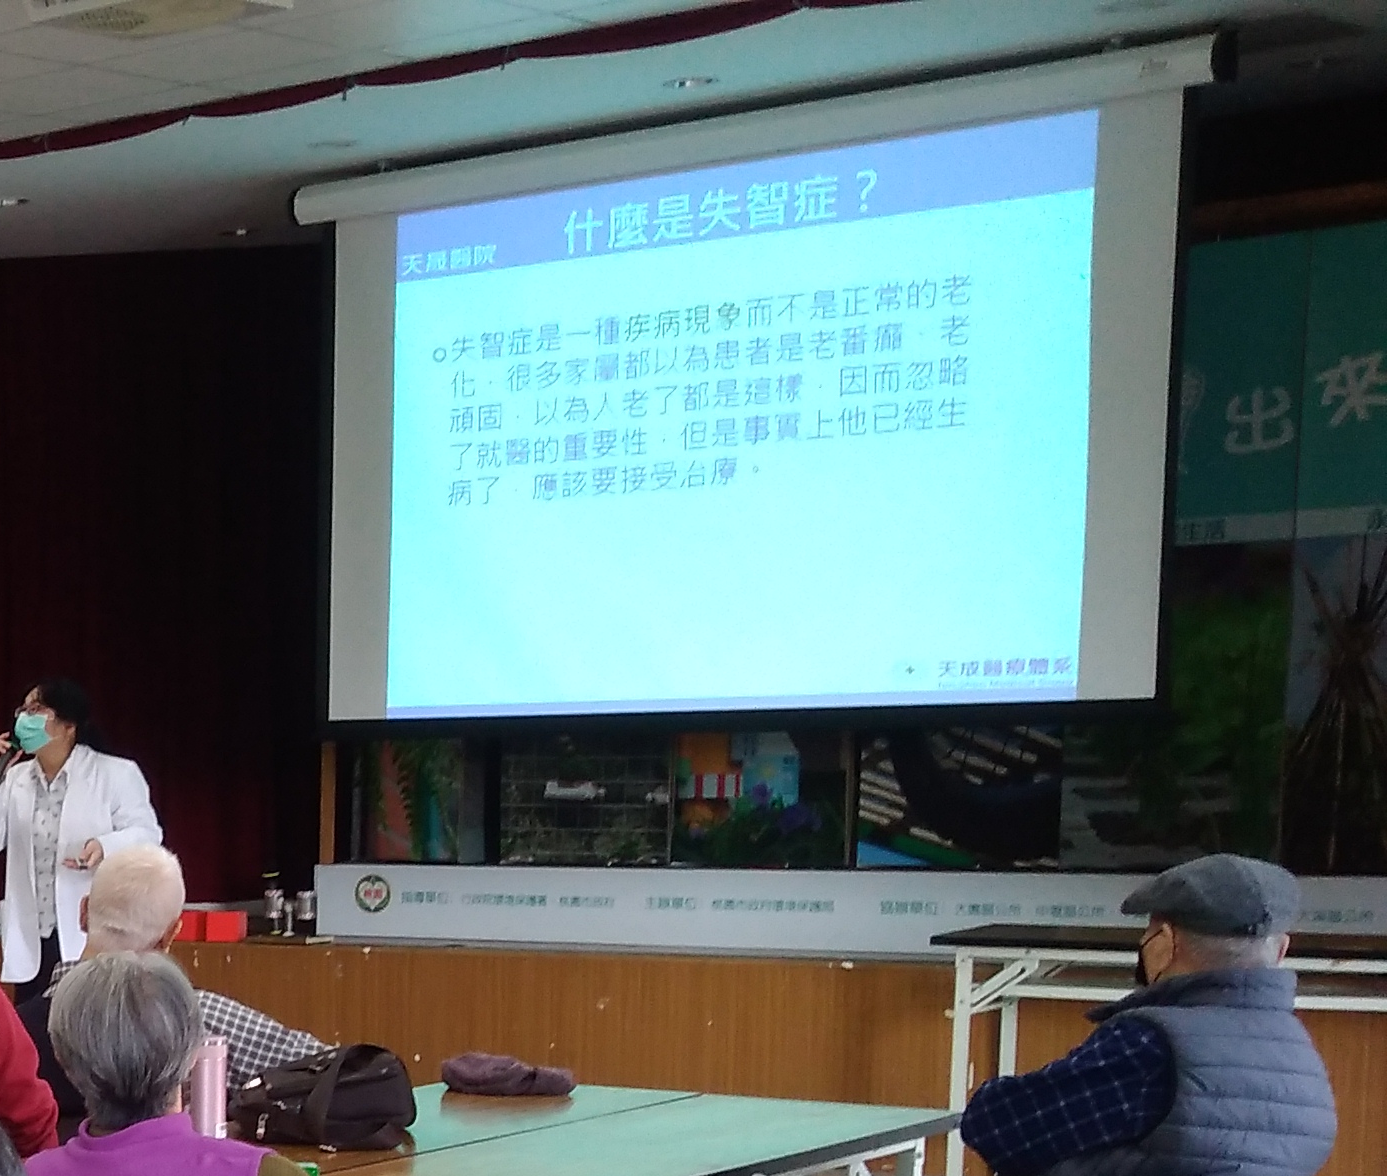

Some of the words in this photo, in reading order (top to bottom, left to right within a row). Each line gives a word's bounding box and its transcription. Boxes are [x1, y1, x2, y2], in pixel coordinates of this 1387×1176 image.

[563, 169, 879, 254] 什麼是失智症？
